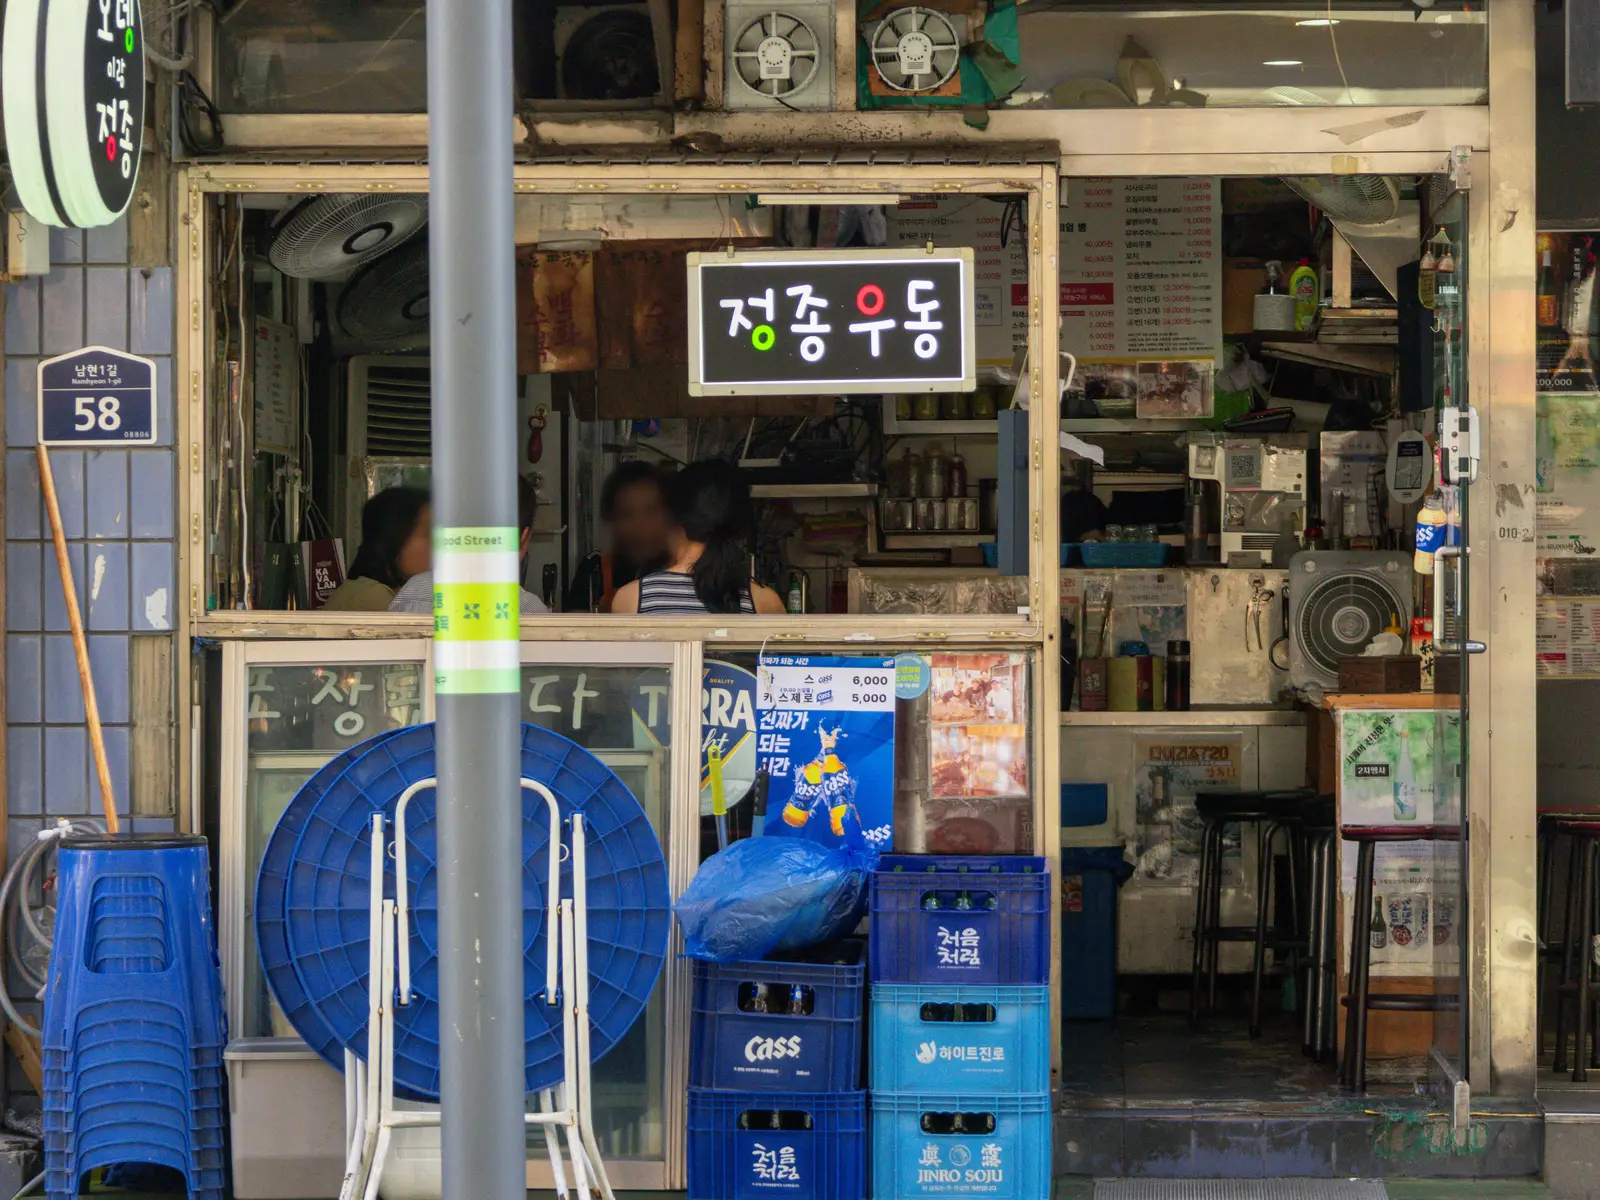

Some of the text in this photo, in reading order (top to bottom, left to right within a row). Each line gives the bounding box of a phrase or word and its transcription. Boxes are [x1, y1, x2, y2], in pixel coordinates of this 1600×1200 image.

[106, 55, 127, 89] 이랑
[96, 98, 134, 179] 정종
[75, 364, 118, 377] 남현1길
[71, 378, 122, 386] Namhyeon 1-gil
[75, 396, 121, 432] 58
[464, 535, 503, 546] Street
[315, 567, 329, 577] KA
[316, 575, 330, 583] VA
[317, 580, 337, 590] LAN
[780, 657, 794, 665] 되는
[794, 657, 809, 666] 시간
[852, 676, 888, 687] 6,000
[851, 693, 887, 705] 5,000
[760, 711, 809, 731] 진짜가
[757, 734, 791, 754] 되는
[937, 926, 981, 947] 처음
[937, 947, 981, 966] 처럼
[939, 1046, 1005, 1062] 하이트진로
[752, 1143, 797, 1165] 처음
[752, 1162, 801, 1181] 처럼
[916, 1169, 1004, 1184] JINRO SOJU
